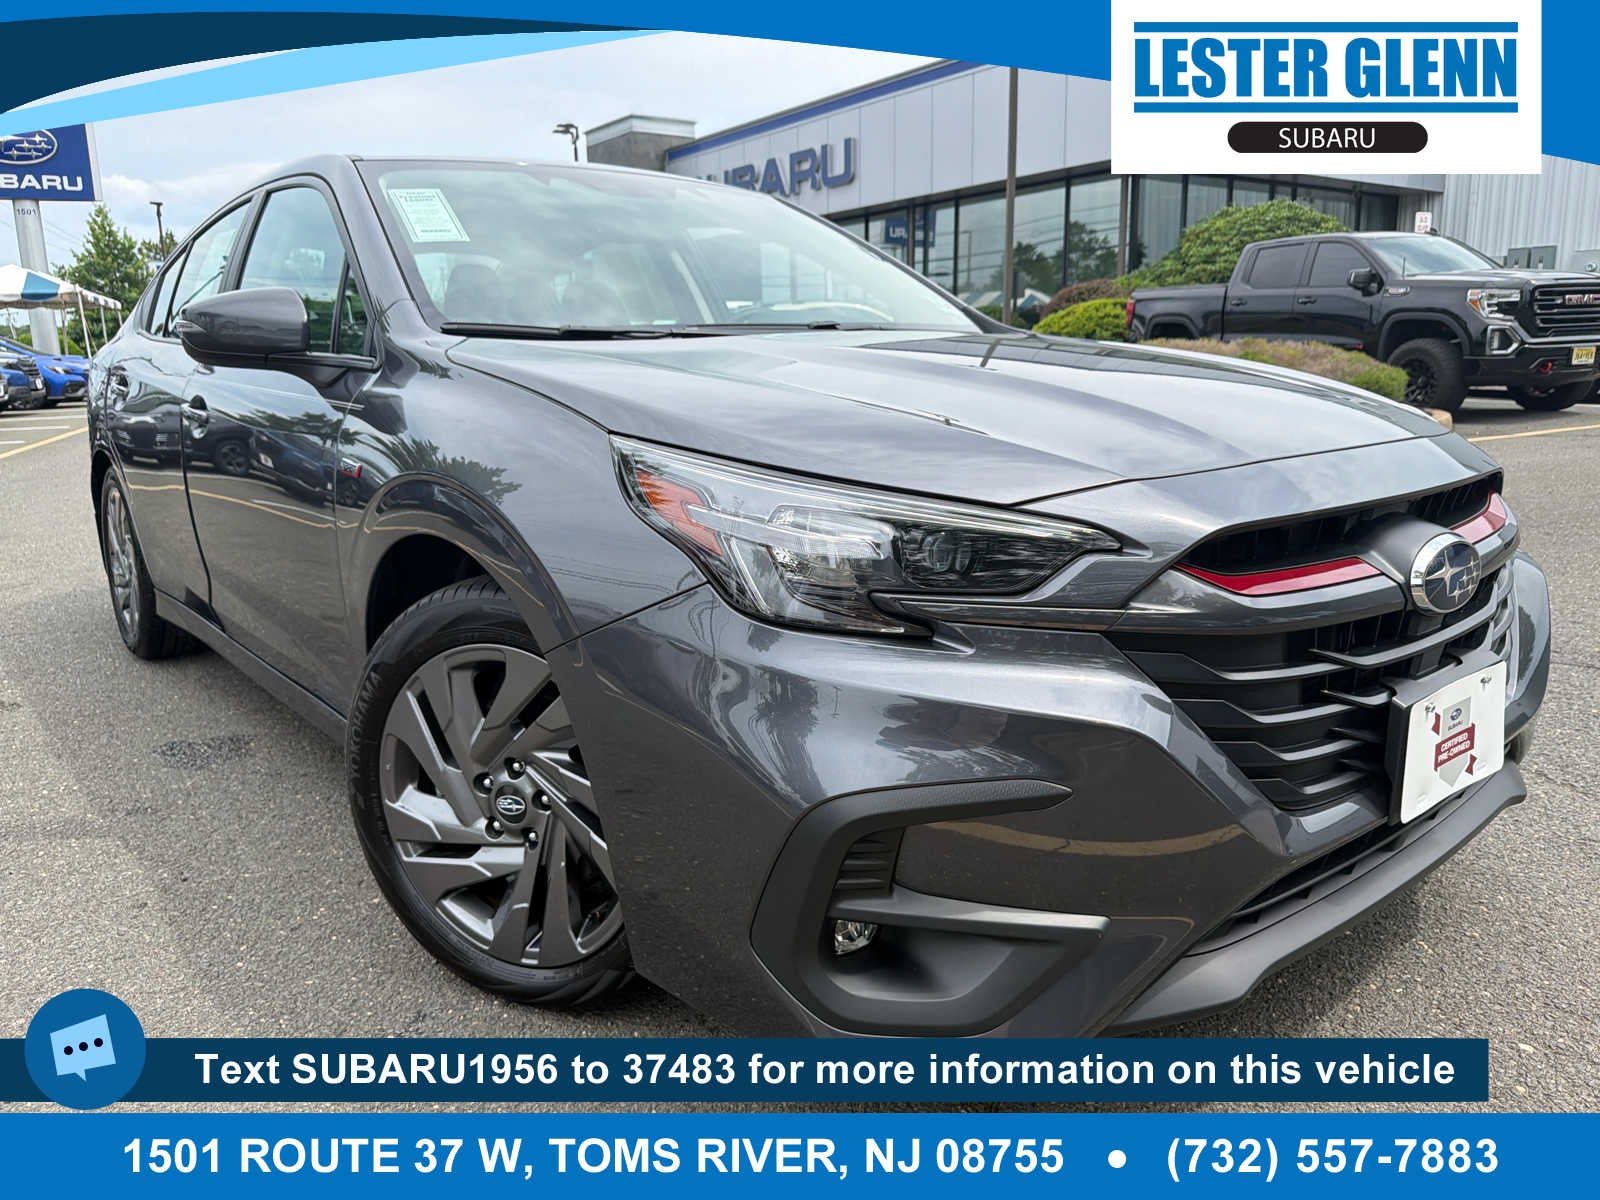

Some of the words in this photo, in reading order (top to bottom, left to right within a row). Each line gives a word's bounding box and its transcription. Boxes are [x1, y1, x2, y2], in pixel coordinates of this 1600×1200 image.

[697, 137, 855, 197] BARU
[16, 208, 38, 216] 1501
[350, 671, 383, 779] YOKOHAMA
[1437, 740, 1470, 763] PRE-OWNED
[1440, 732, 1468, 752] CERTIFIED
